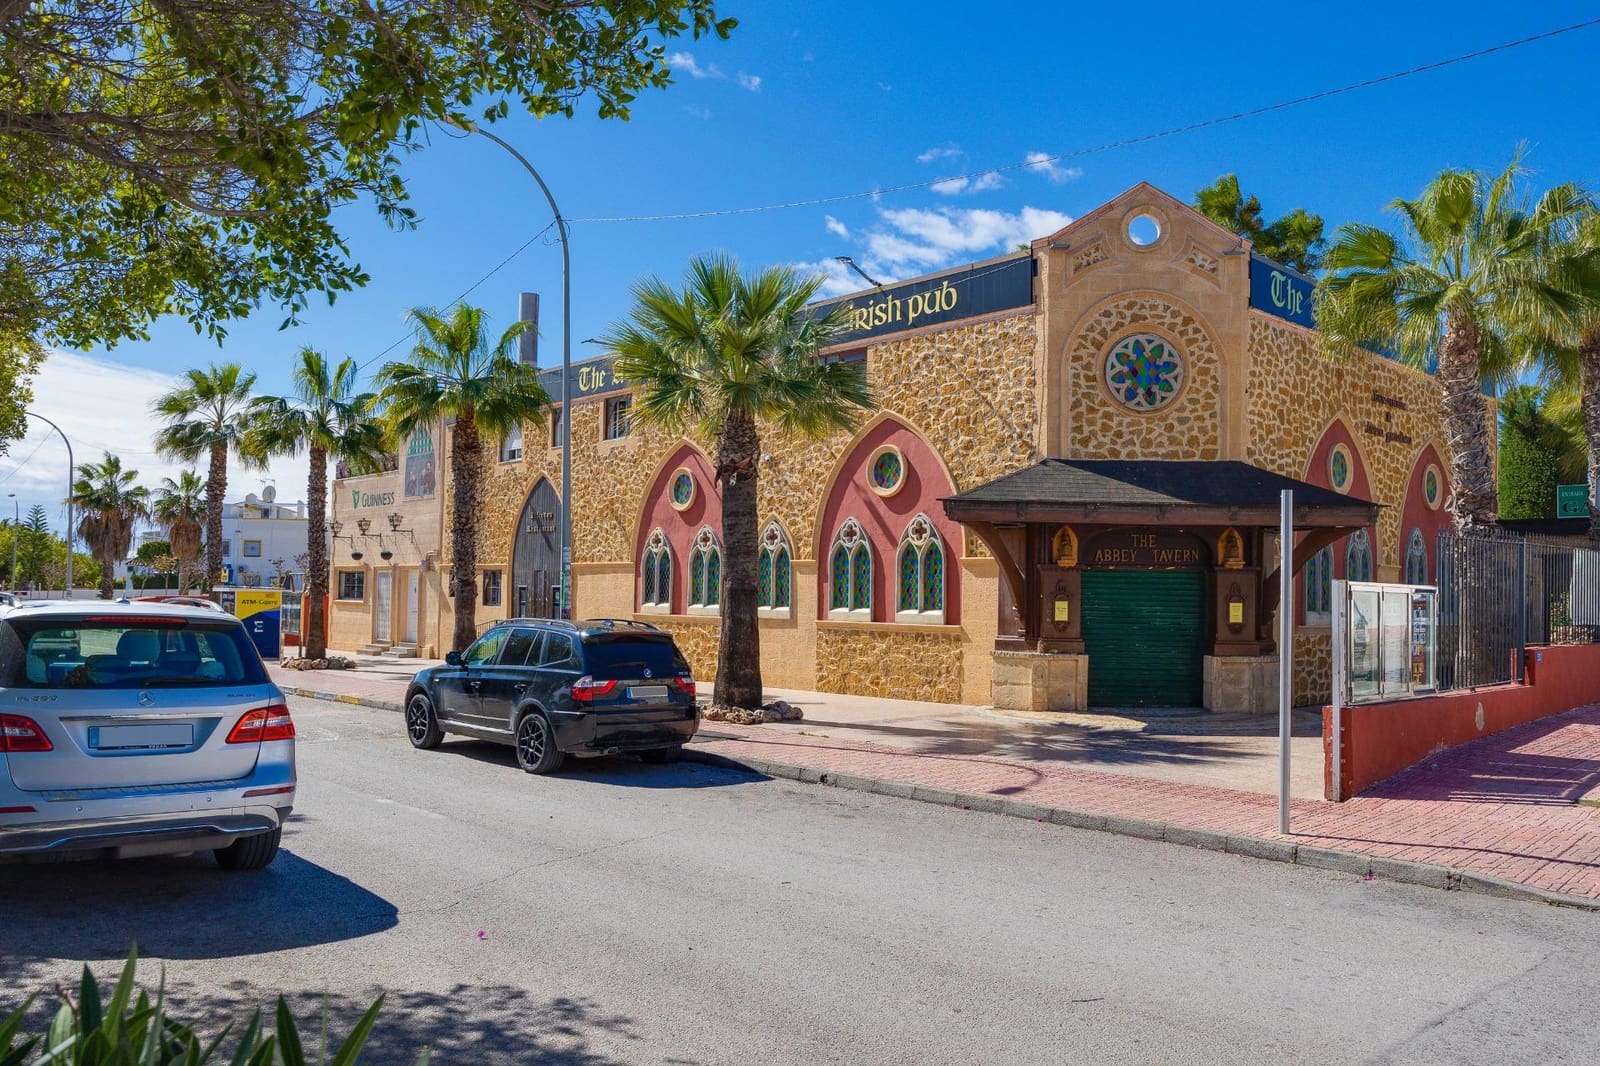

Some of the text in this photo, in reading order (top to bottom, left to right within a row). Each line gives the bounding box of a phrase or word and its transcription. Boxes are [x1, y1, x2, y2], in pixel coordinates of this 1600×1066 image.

[907, 280, 958, 326] pub
[1270, 270, 1303, 316] The
[578, 365, 606, 392] The
[361, 491, 395, 508] GUINNESS
[1130, 534, 1157, 548] THE
[1094, 548, 1200, 562] ABBEY TAVERN
